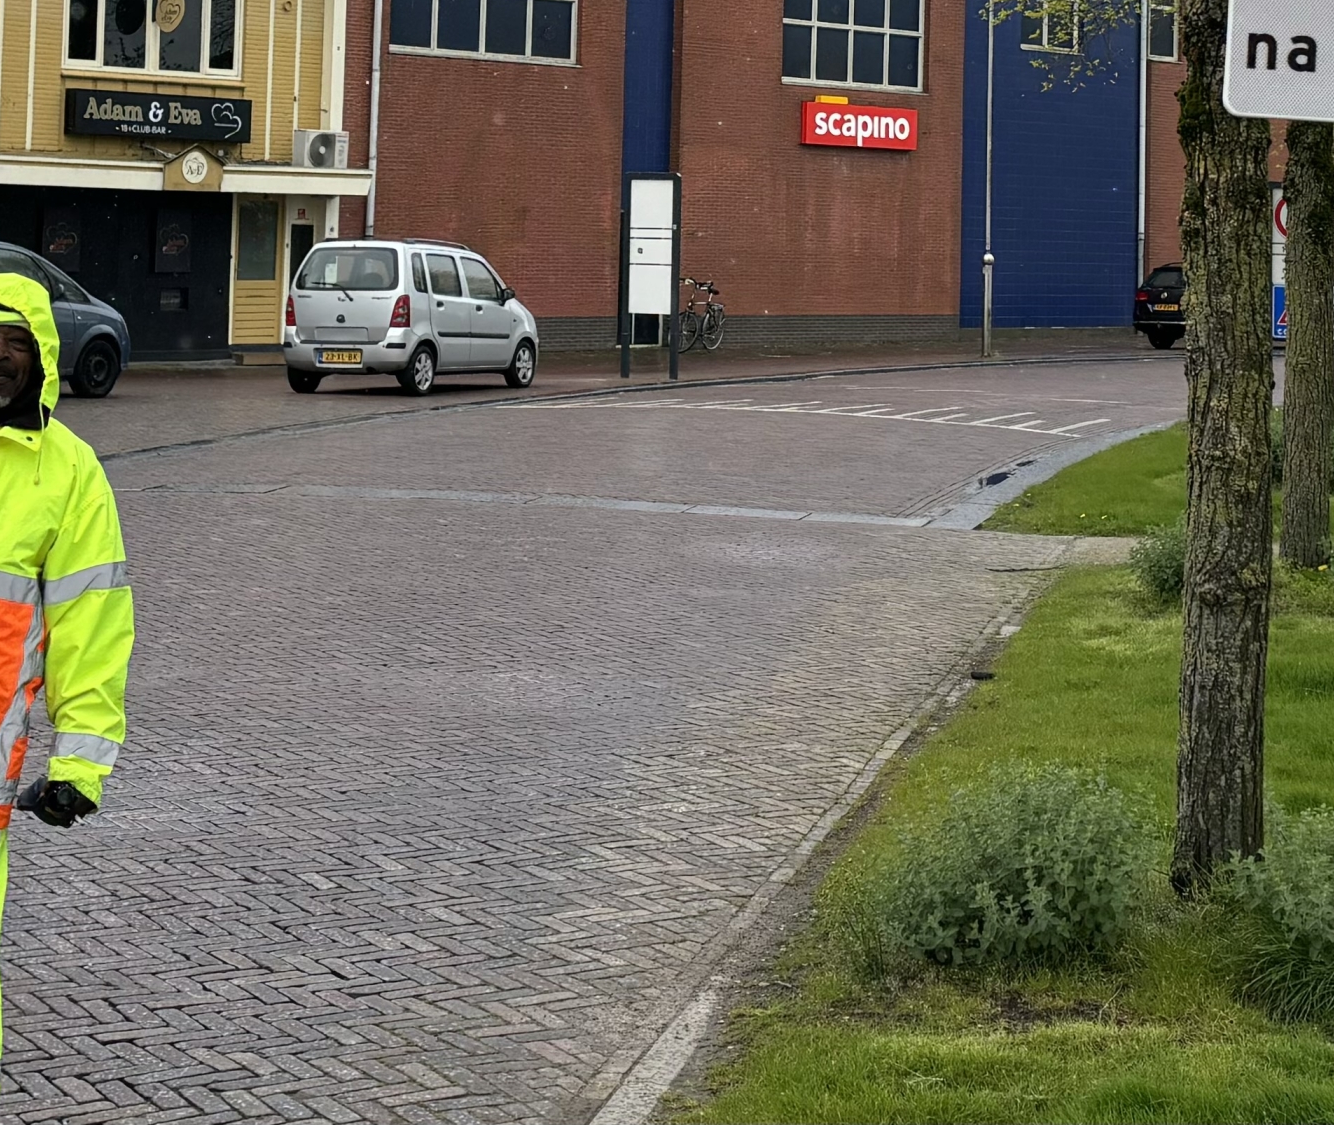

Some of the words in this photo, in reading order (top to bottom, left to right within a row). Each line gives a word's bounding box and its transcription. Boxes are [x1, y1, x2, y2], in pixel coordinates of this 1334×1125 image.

[1246, 31, 1318, 73] na
[83, 96, 144, 123] Adam
[148, 101, 165, 123] &
[168, 102, 202, 125] Eva
[814, 111, 911, 147] scapino
